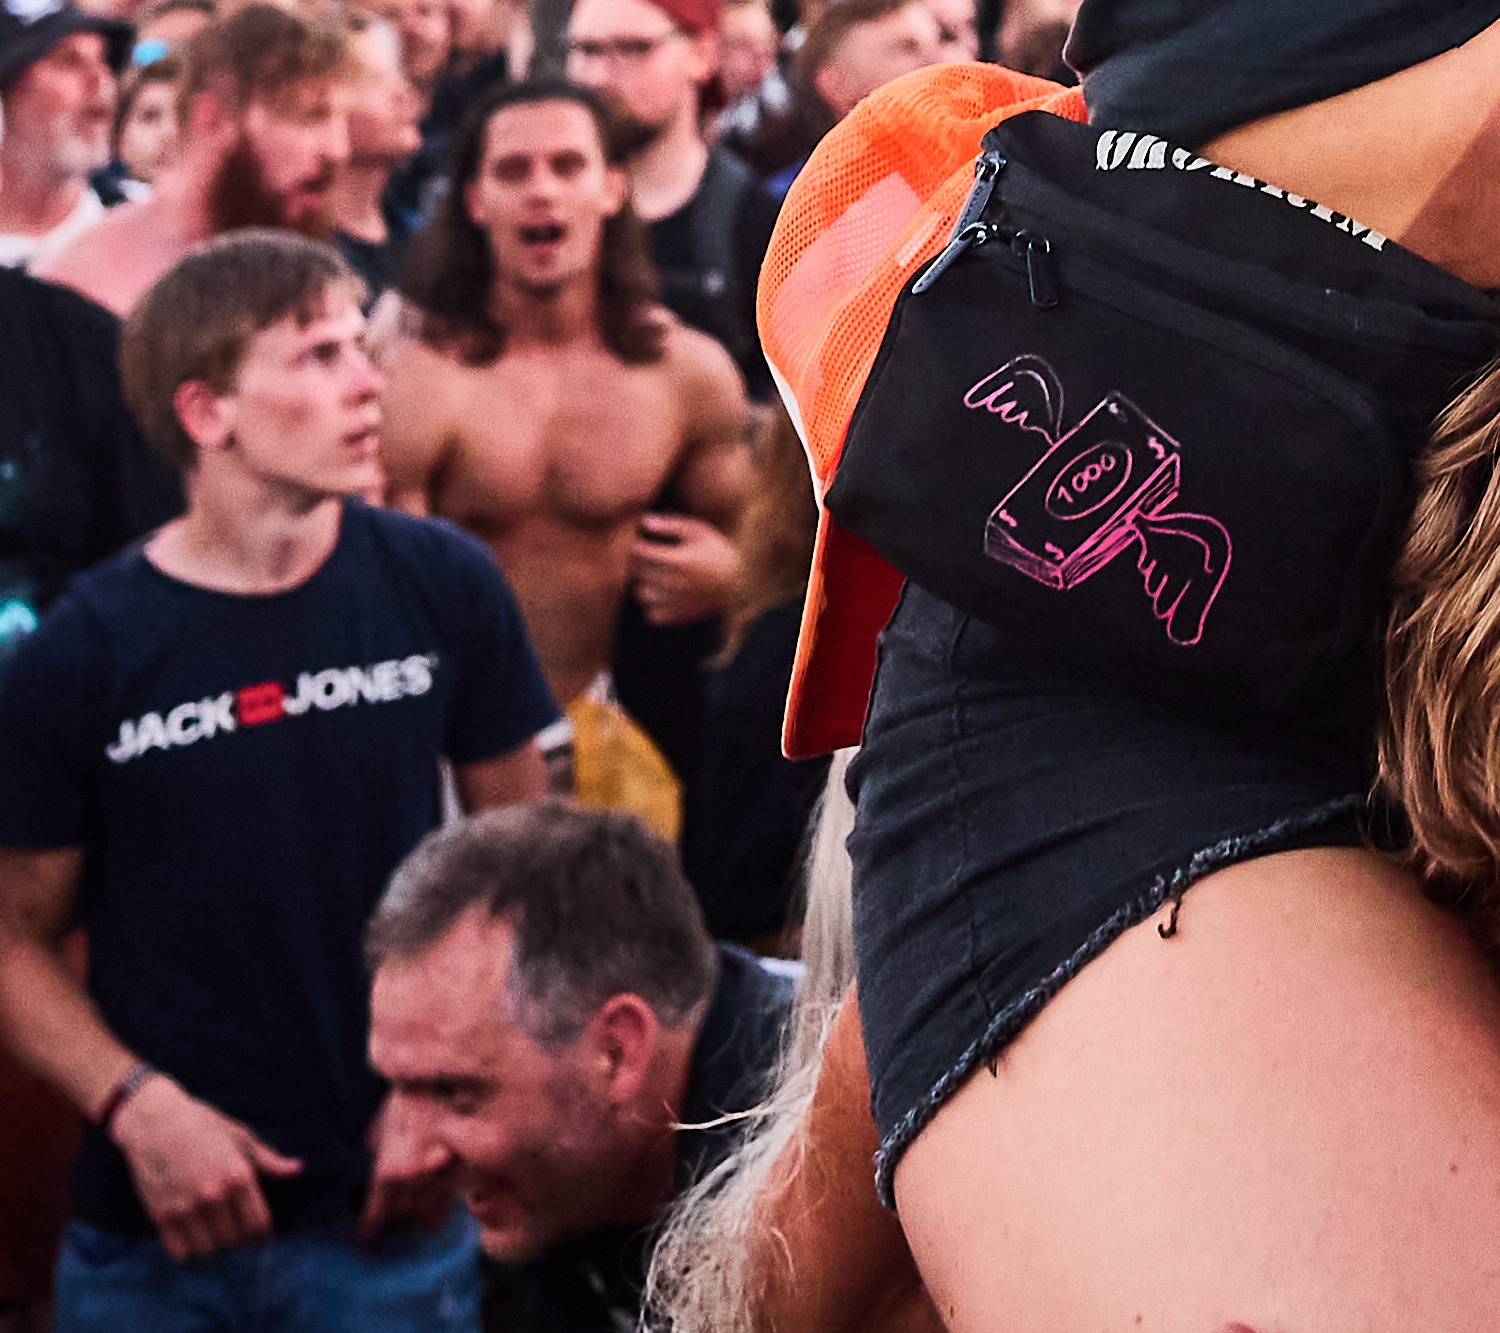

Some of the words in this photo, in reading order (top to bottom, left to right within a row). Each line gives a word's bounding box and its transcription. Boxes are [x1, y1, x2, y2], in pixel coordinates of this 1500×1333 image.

[1057, 453, 1117, 503] 1000
[105, 690, 236, 763] JACK
[282, 654, 433, 716] JONES
